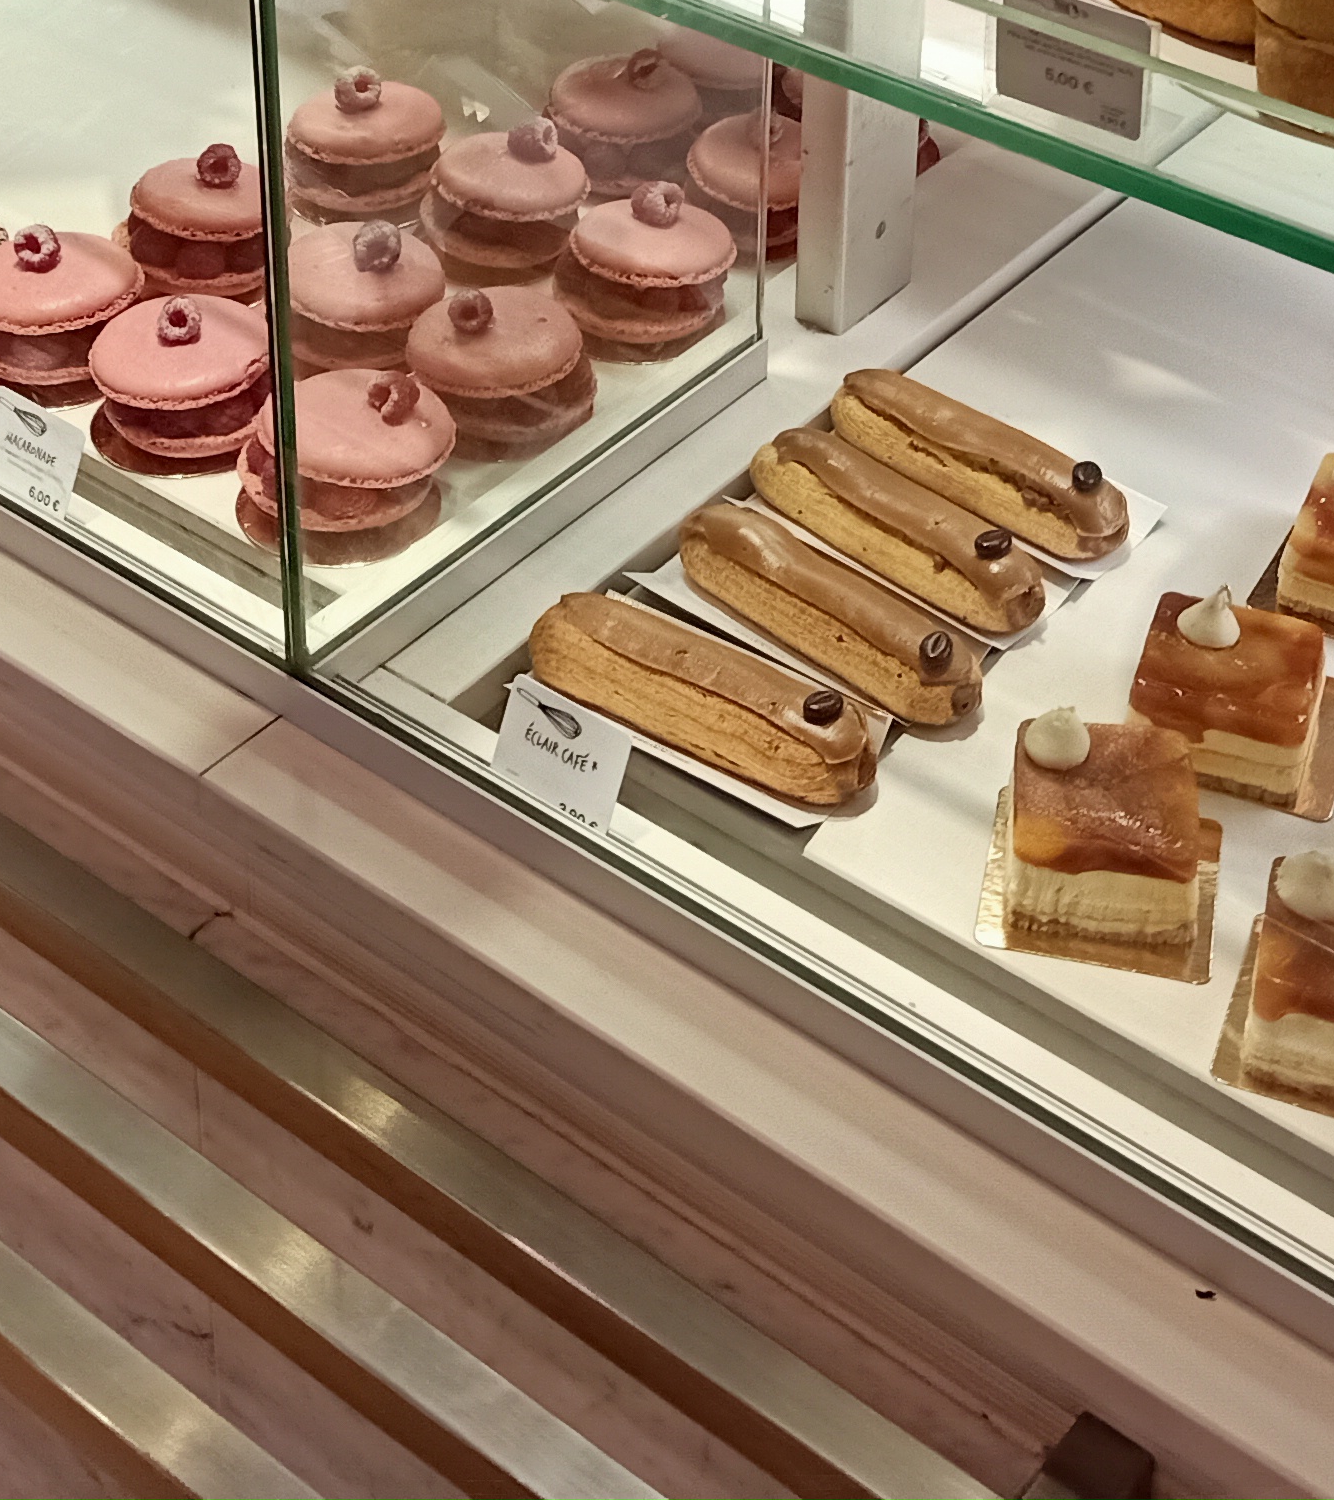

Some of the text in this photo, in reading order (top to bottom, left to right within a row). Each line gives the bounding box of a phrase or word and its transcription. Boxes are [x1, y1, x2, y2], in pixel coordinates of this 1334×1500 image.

[4, 433, 58, 467] MACARONADE
[29, 486, 61, 512] 6,00 €
[524, 722, 590, 772] ÉCLAIR CAFÉ
